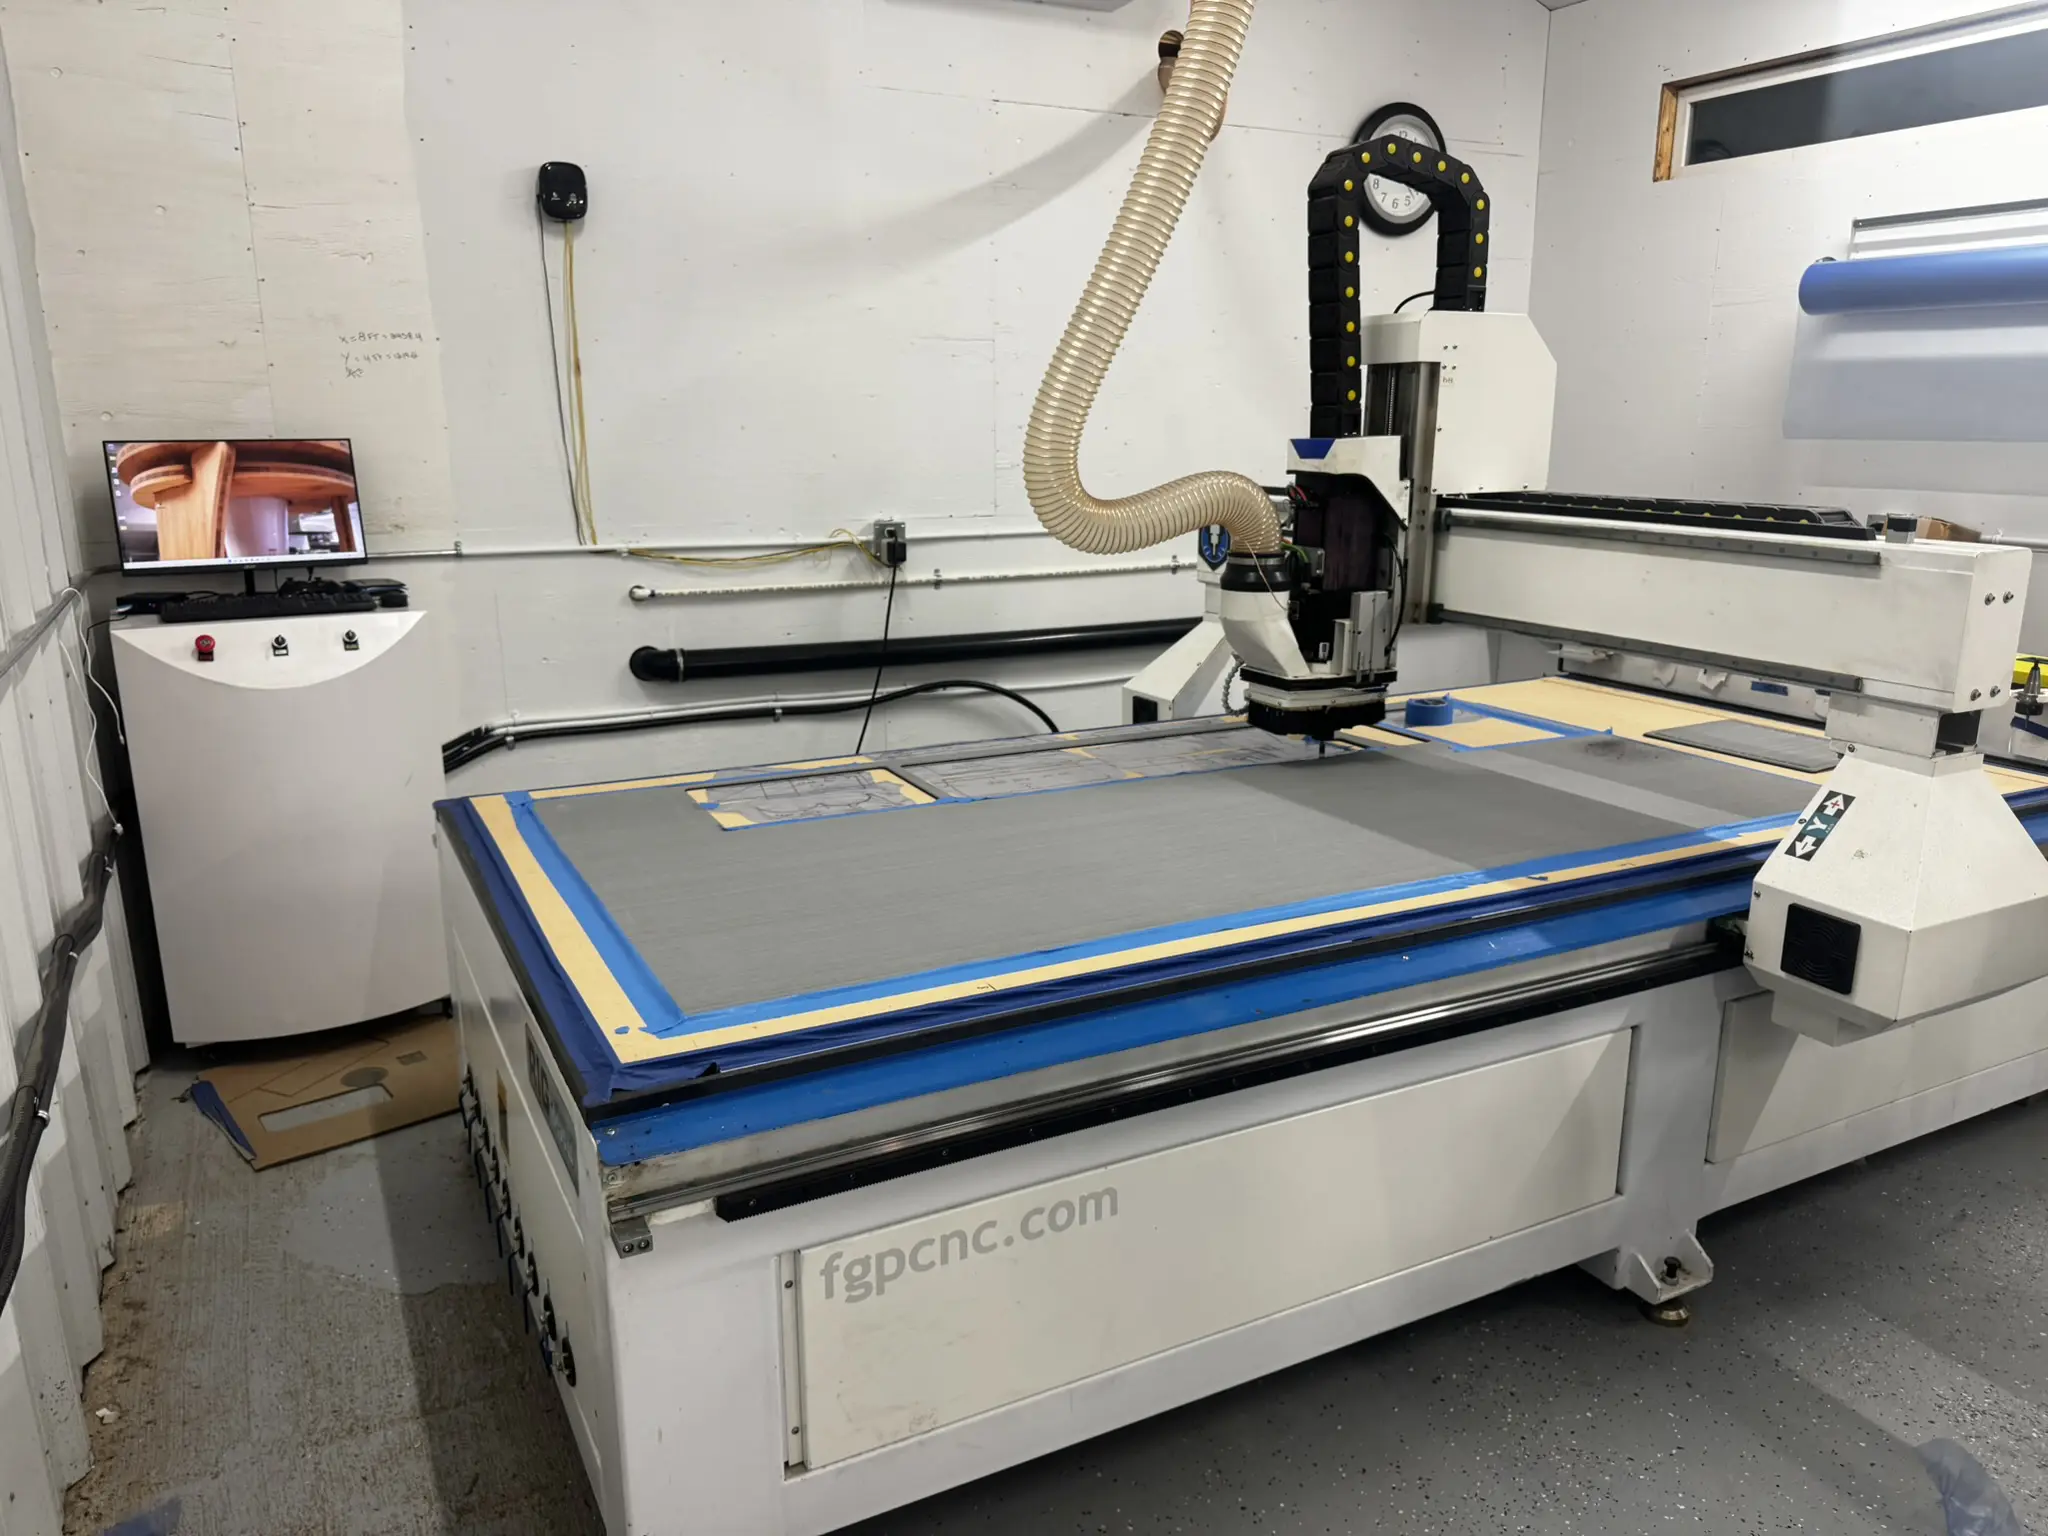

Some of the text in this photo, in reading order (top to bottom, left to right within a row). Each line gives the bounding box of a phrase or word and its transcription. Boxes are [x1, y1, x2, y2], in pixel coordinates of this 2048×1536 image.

[1372, 178, 1380, 190] 8
[1380, 192, 1388, 204] 7
[1392, 198, 1400, 210] 6
[1404, 196, 1412, 207] 5
[1805, 815, 1829, 831] Y
[819, 1186, 1119, 1304] fgpcnc.com
